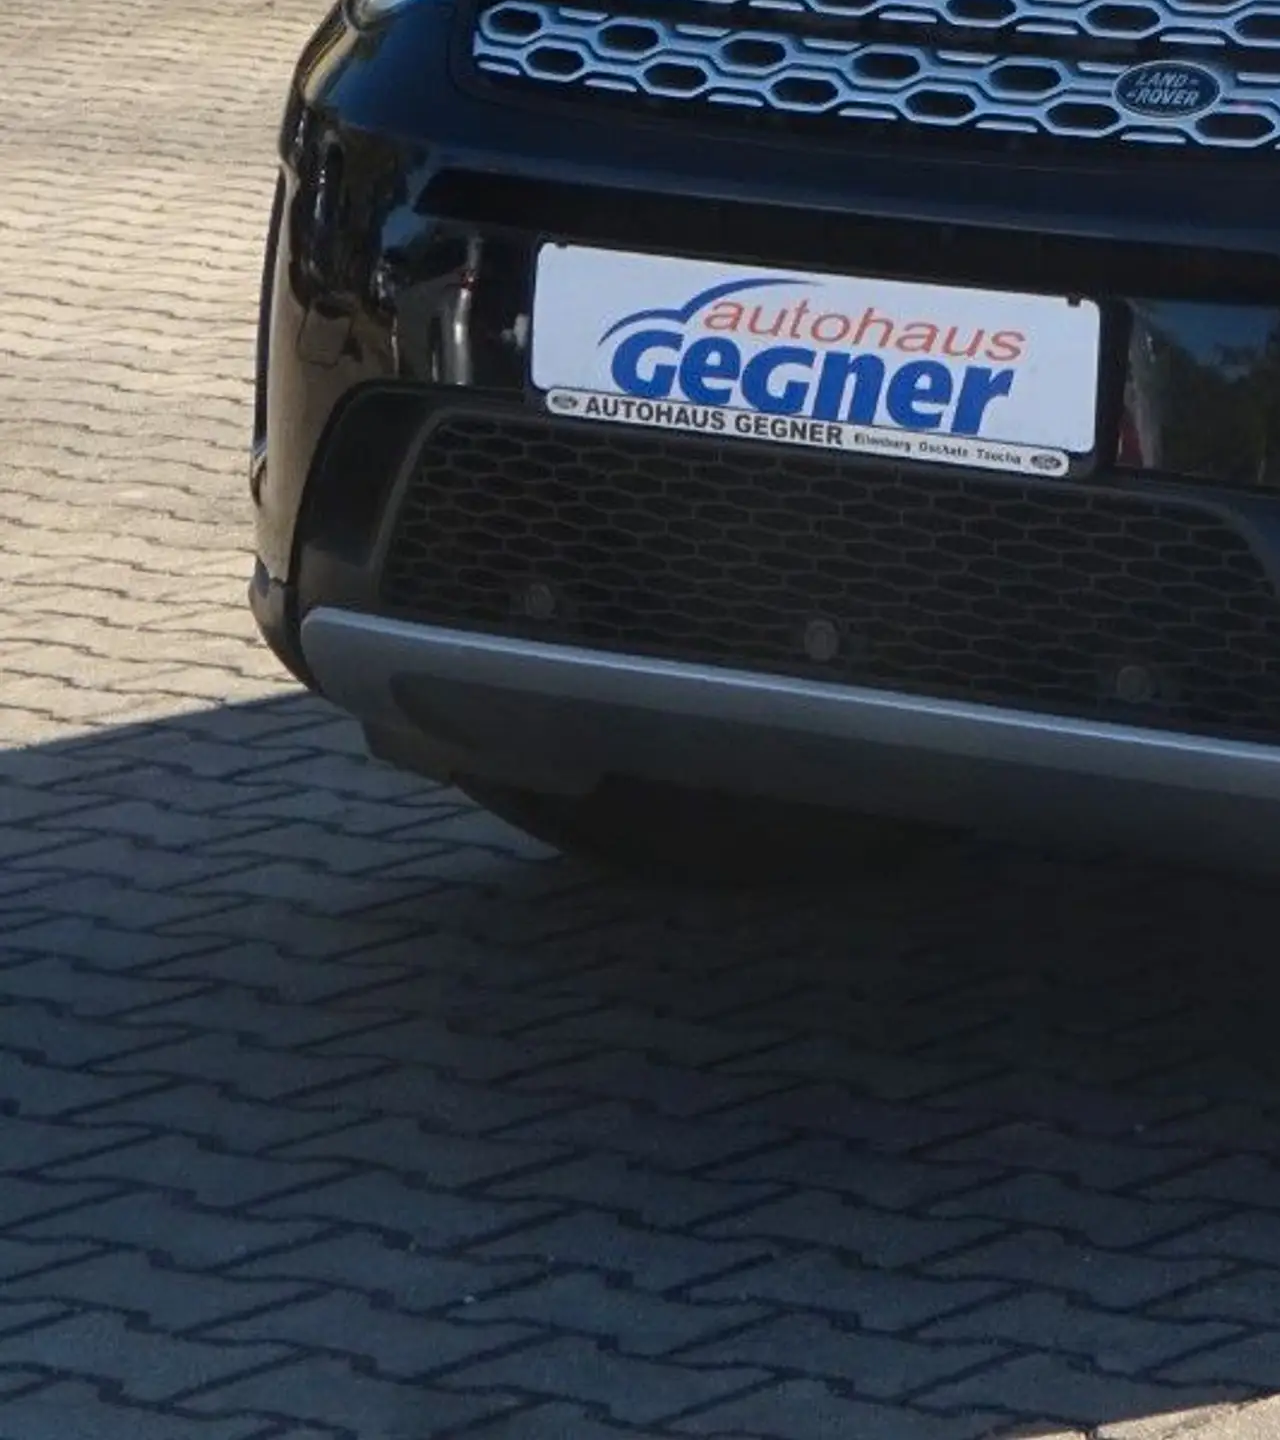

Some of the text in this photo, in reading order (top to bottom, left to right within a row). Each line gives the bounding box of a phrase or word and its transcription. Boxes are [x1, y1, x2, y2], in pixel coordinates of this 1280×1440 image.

[1135, 71, 1189, 87] LAND
[1134, 88, 1200, 106] ROVER
[703, 298, 1028, 361] autohaus
[584, 396, 726, 431] AUTOHAUS
[733, 413, 844, 445] GEGNER
